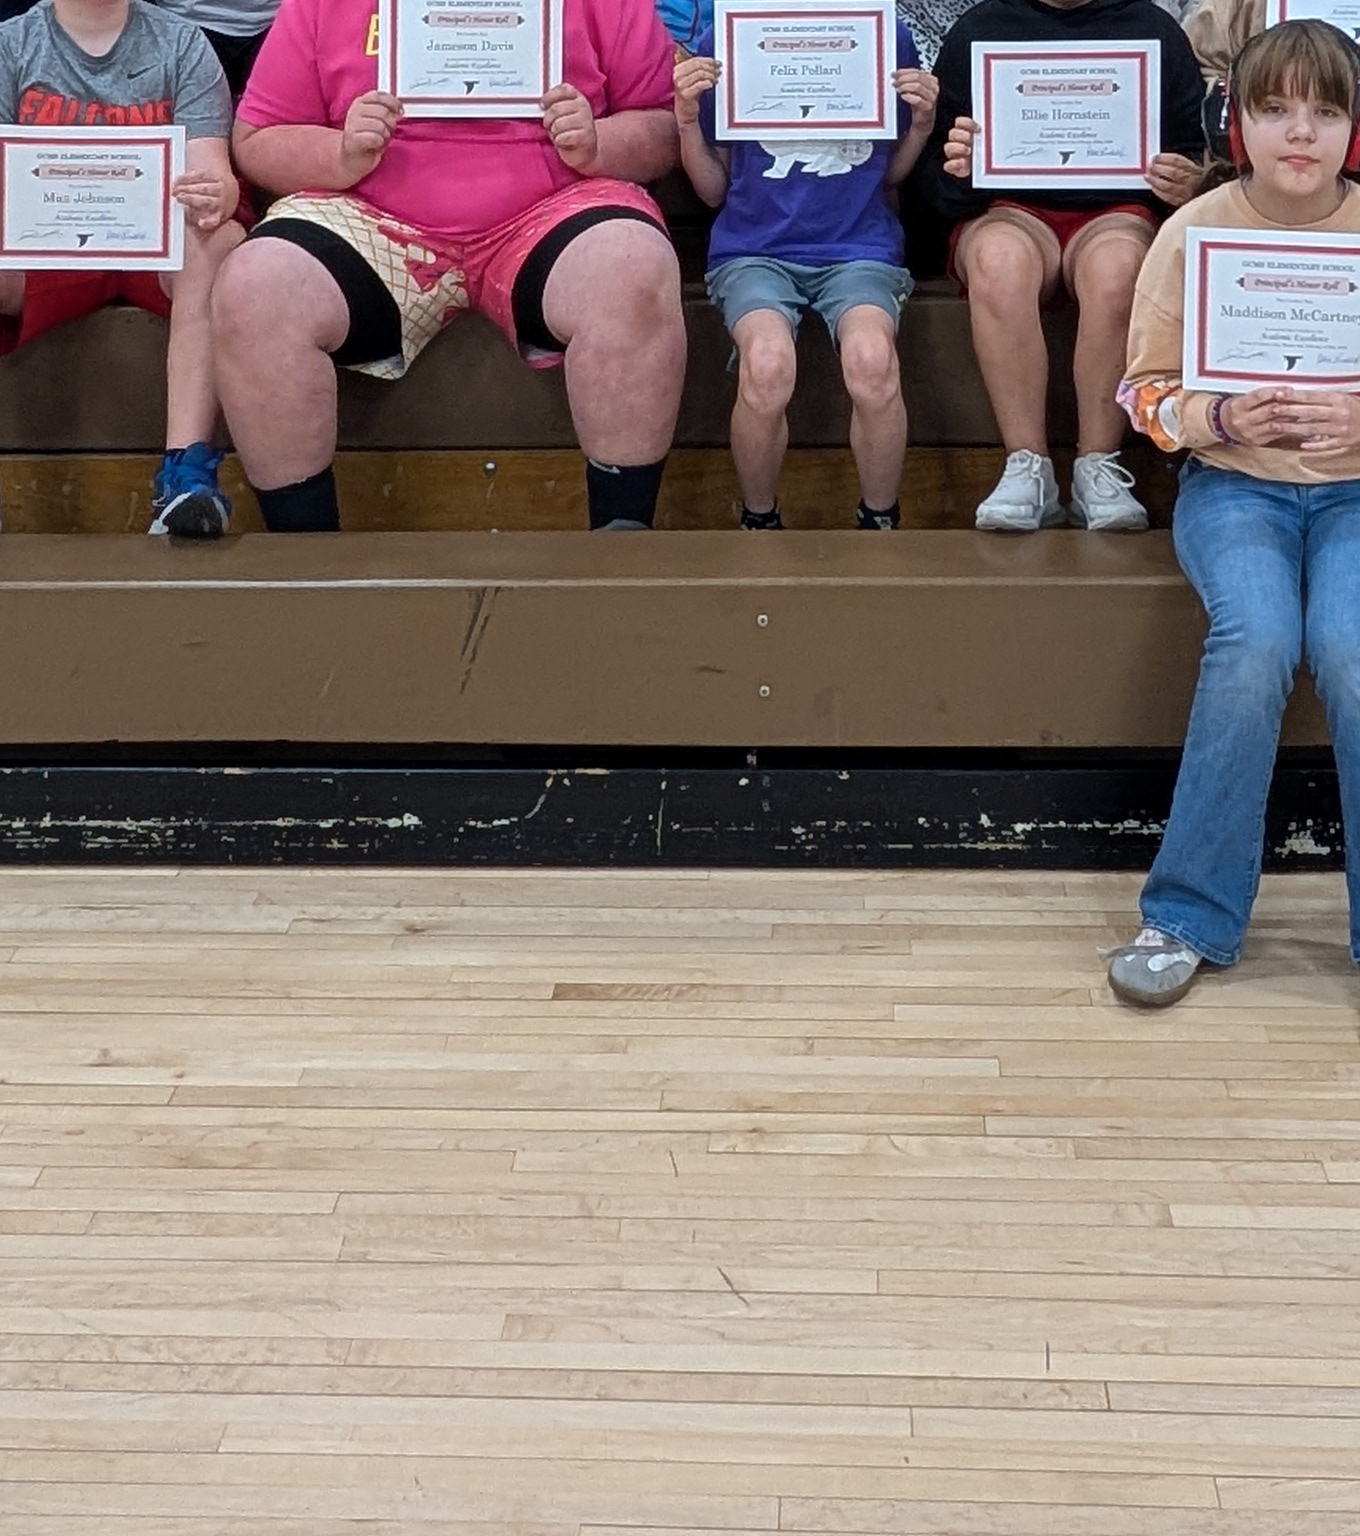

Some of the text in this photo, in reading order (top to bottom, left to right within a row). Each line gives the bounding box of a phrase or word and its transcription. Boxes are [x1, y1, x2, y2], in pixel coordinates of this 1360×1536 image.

[426, 41, 513, 50] Jameson Davis
[769, 65, 841, 75] Felix Pollard
[1021, 108, 1109, 120] Ellie Hornstein
[73, 193, 124, 204] Johnson
[1322, 263, 1355, 272] SCHOOL
[1220, 305, 1286, 319] Maddison
